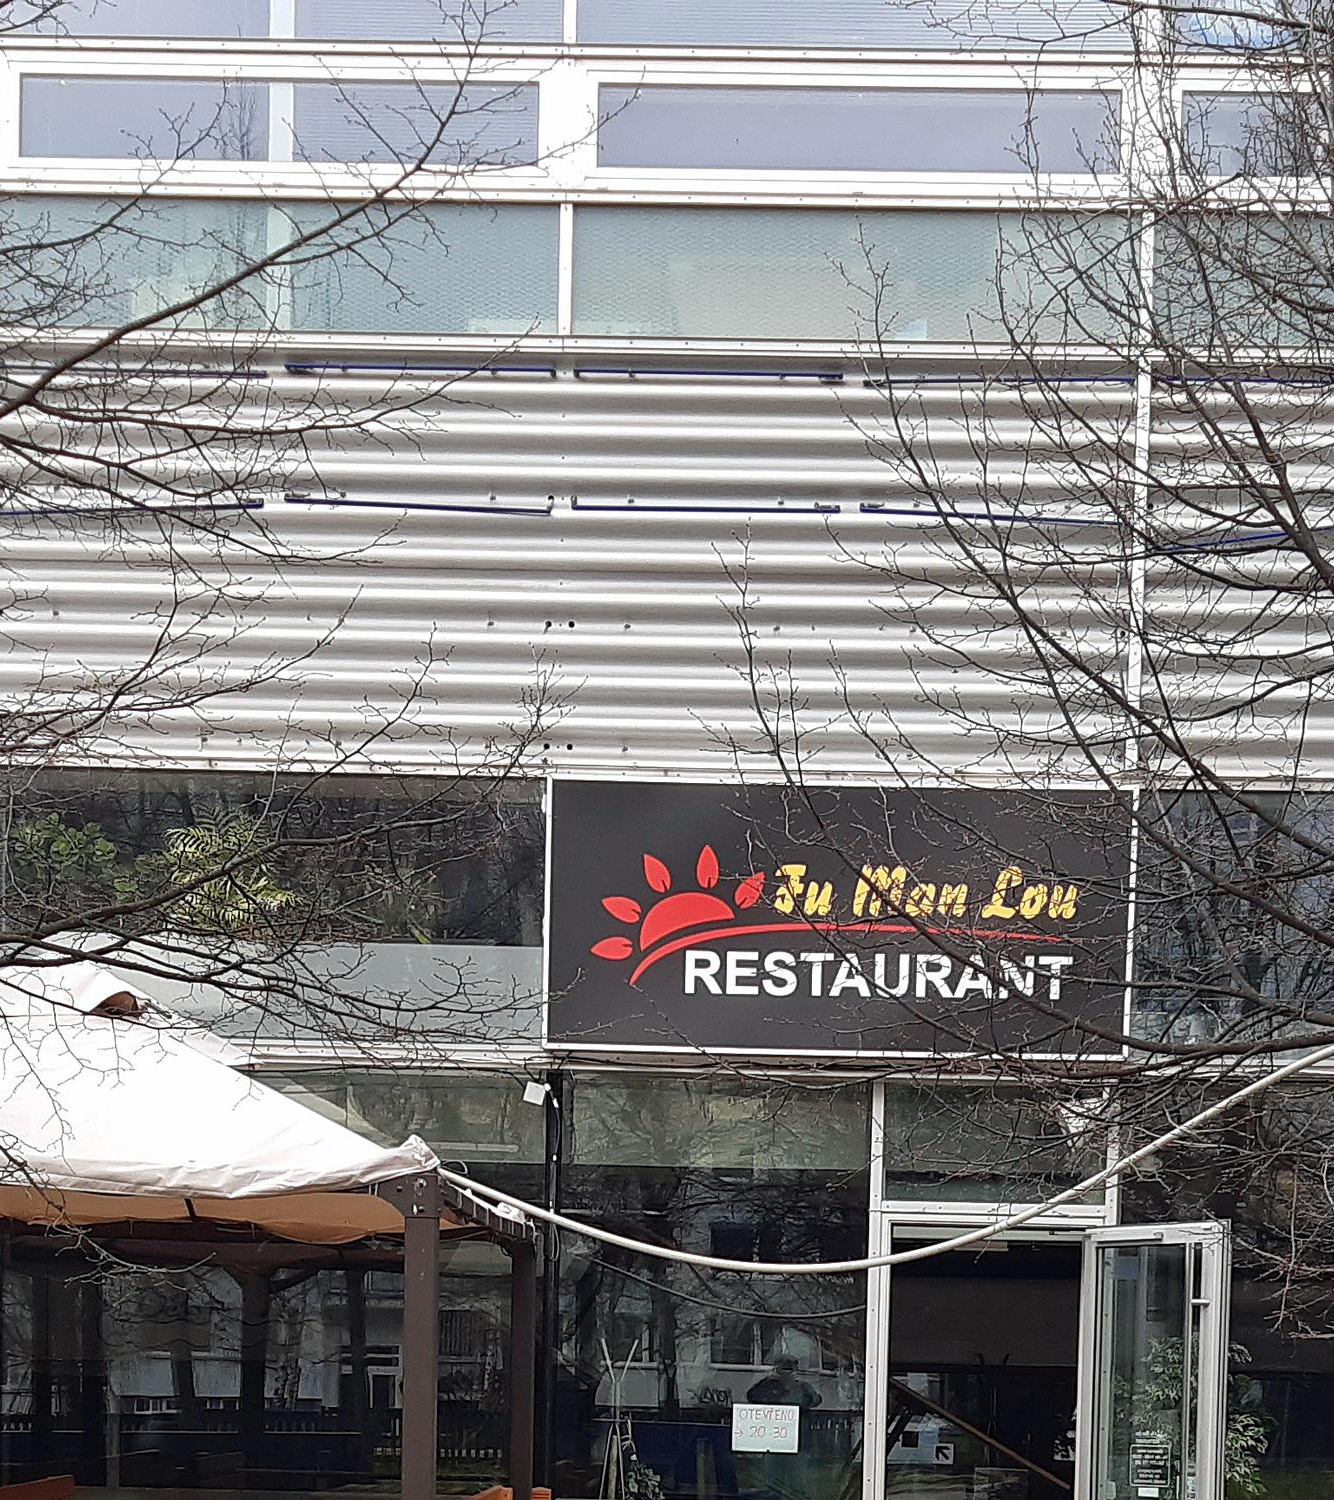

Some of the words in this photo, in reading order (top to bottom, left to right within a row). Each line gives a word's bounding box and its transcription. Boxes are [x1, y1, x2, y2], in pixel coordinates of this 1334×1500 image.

[774, 864, 833, 916] Fu
[852, 865, 968, 918] Man
[981, 865, 1080, 919] Lou
[683, 949, 1074, 1000] RESTAURANT
